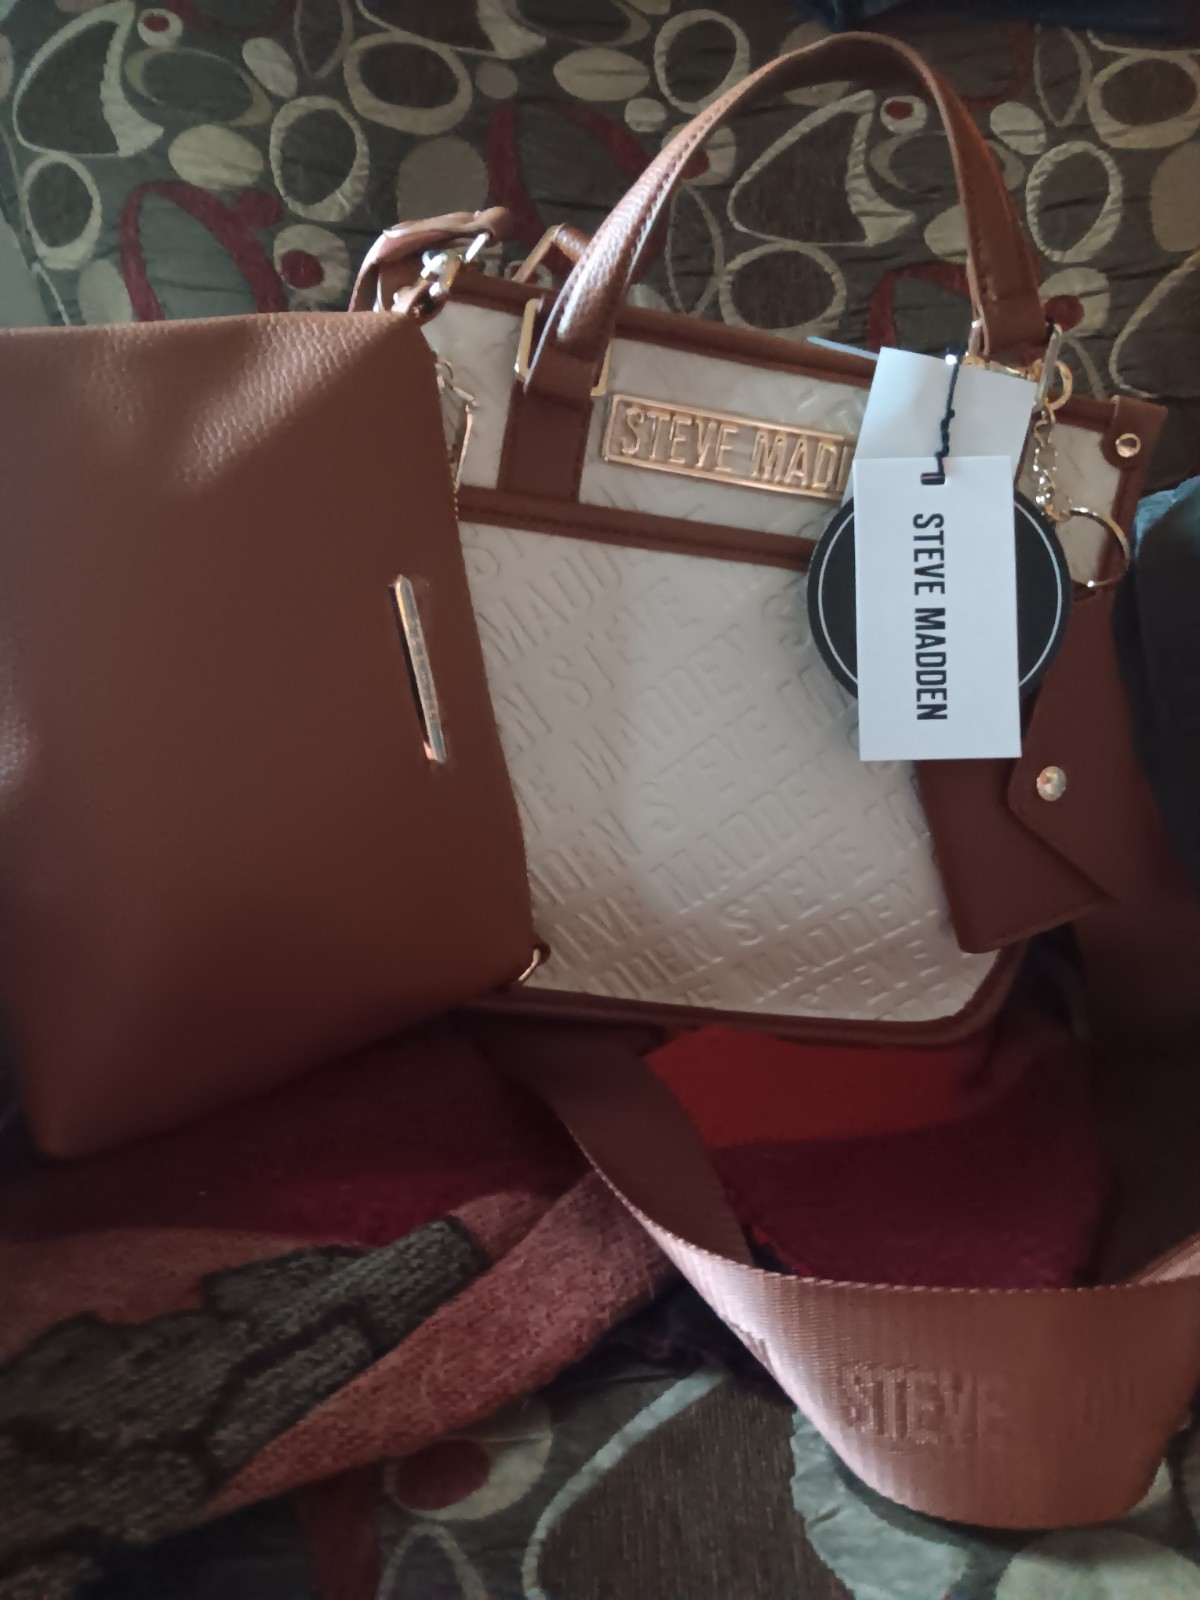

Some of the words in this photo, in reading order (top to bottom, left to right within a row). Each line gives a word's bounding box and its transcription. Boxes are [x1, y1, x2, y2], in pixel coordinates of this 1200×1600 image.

[620, 405, 741, 475] STEVE
[750, 429, 855, 492] MAD
[473, 541, 641, 668] MADD
[912, 512, 946, 597] STEVE
[542, 573, 704, 715] STEVE
[914, 607, 949, 721] MADDEN
[567, 621, 773, 795] MADDEN
[630, 701, 791, 842] STEVE
[648, 749, 857, 917] MADDEN
[714, 825, 873, 951] STEVE
